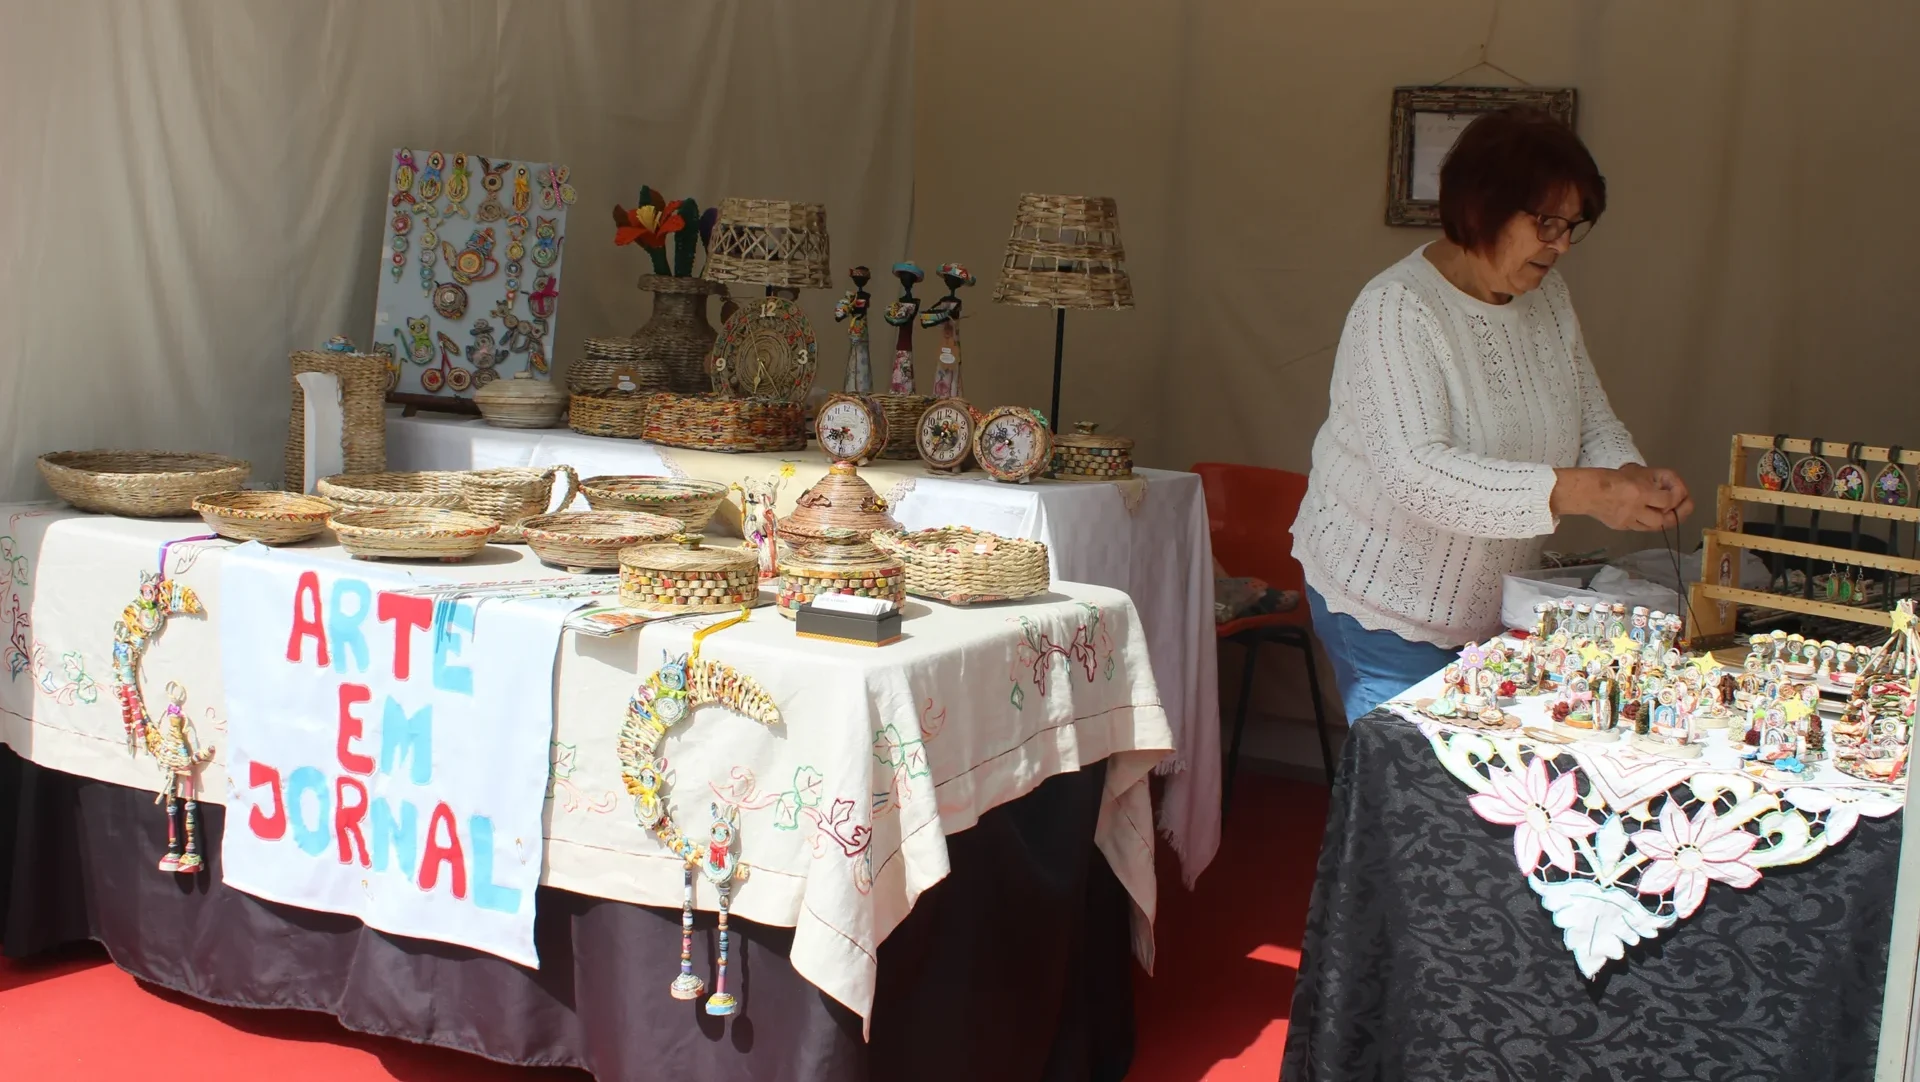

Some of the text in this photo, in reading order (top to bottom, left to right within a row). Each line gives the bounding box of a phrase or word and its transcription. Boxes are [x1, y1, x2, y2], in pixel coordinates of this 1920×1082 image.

[760, 302, 777, 318] 12
[798, 349, 809, 365] 3
[715, 357, 727, 371] 9
[936, 410, 943, 420] 11
[945, 409, 952, 418] 12
[927, 417, 936, 426] 10
[960, 421, 966, 430] 2
[923, 428, 929, 437] 9
[961, 432, 967, 441] 3
[925, 439, 931, 448] 8
[956, 442, 962, 451] 4
[939, 451, 945, 460] 6
[949, 450, 955, 459] 5
[286, 571, 475, 697] ARTE
[336, 682, 434, 786] EM
[248, 760, 523, 915] JORNAL
